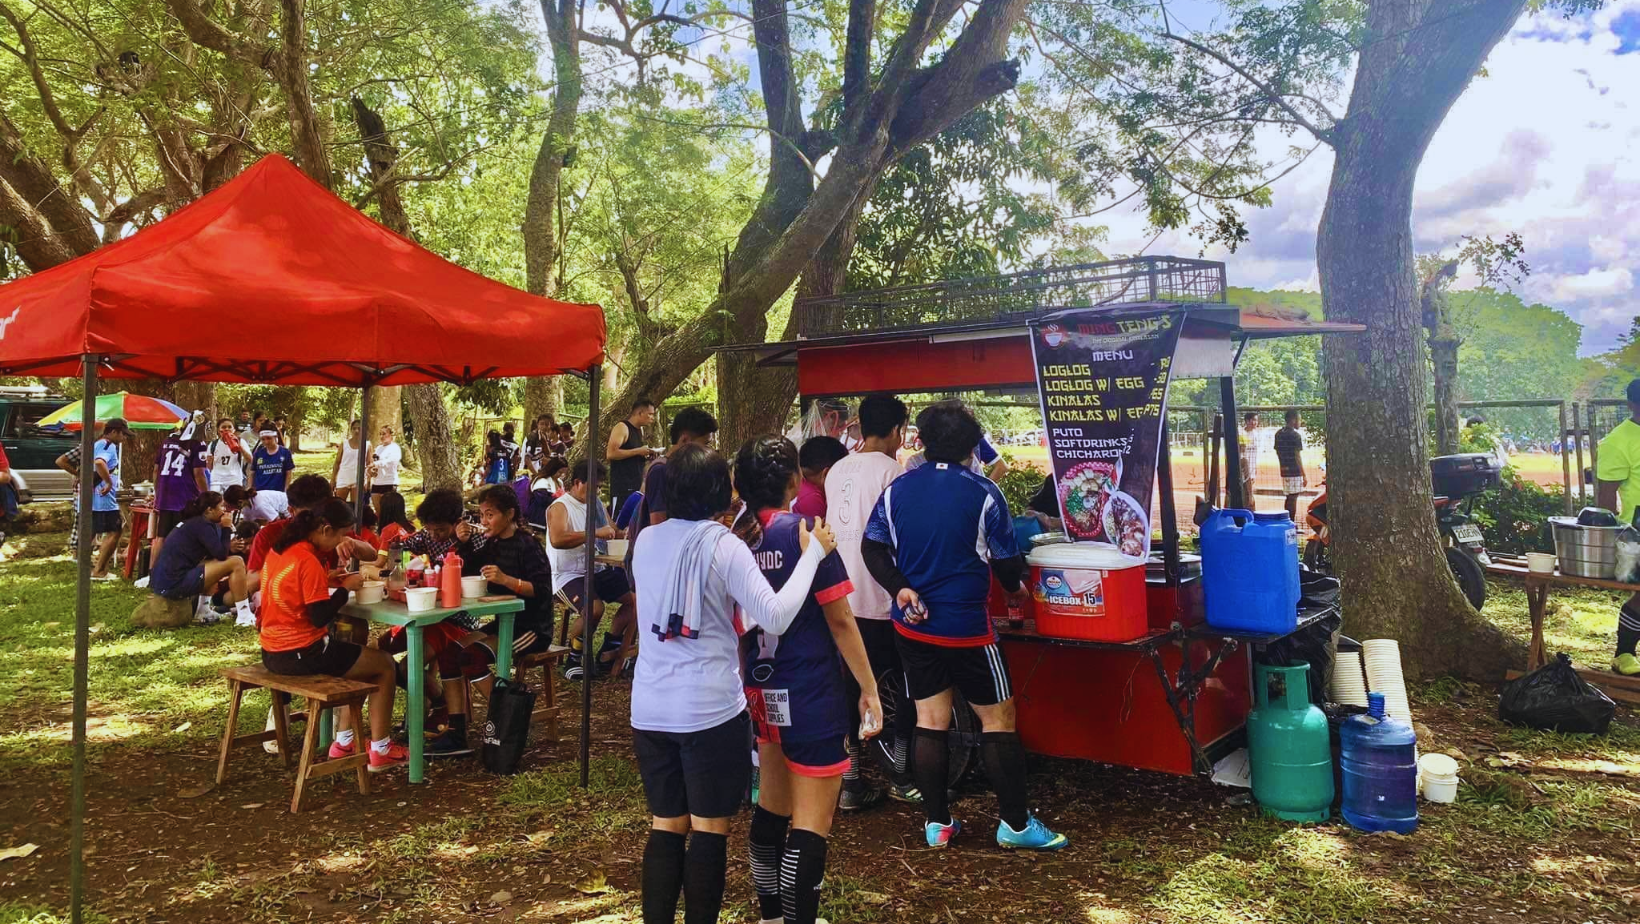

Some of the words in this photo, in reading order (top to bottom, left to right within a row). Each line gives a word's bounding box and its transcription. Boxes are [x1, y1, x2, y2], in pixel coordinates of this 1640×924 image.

[1116, 314, 1171, 334] TENG'S
[1093, 350, 1134, 362] MENU
[1043, 364, 1091, 377] LOGLOG
[1046, 379, 1094, 392] LOGLOG
[1115, 376, 1145, 390] EGG
[1048, 394, 1101, 407] KINALAS
[1050, 409, 1104, 422] KINALAS
[1053, 428, 1083, 438] PUTO
[1055, 437, 1127, 448] SOFTDRINKS
[160, 450, 185, 477] 14
[221, 456, 231, 466] 27
[499, 458, 504, 471] 3
[839, 478, 853, 525] 3
[1049, 595, 1082, 605] ICEBOX
[1084, 593, 1096, 605] 15
[777, 692, 788, 702] AND
